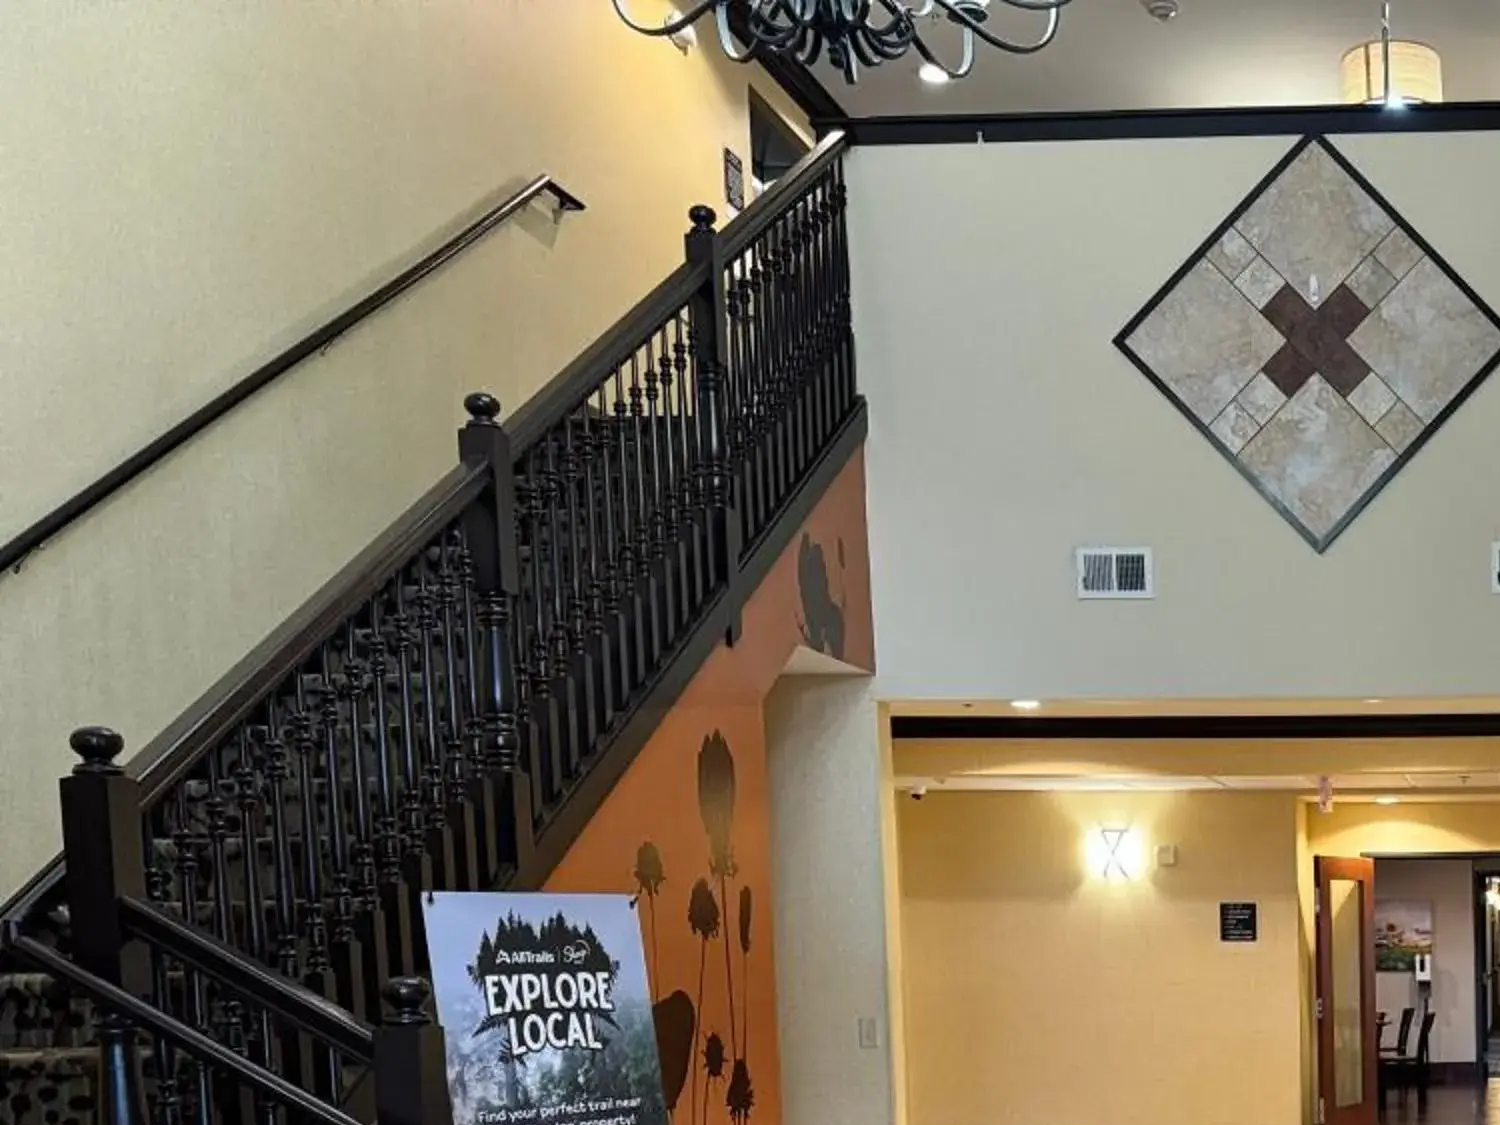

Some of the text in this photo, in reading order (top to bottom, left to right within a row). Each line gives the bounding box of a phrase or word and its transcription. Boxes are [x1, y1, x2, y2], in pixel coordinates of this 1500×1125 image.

[485, 971, 613, 1016] EXPLORE
[508, 1011, 603, 1055] LOCAL
[478, 1097, 641, 1122] Find your perfect trail near
